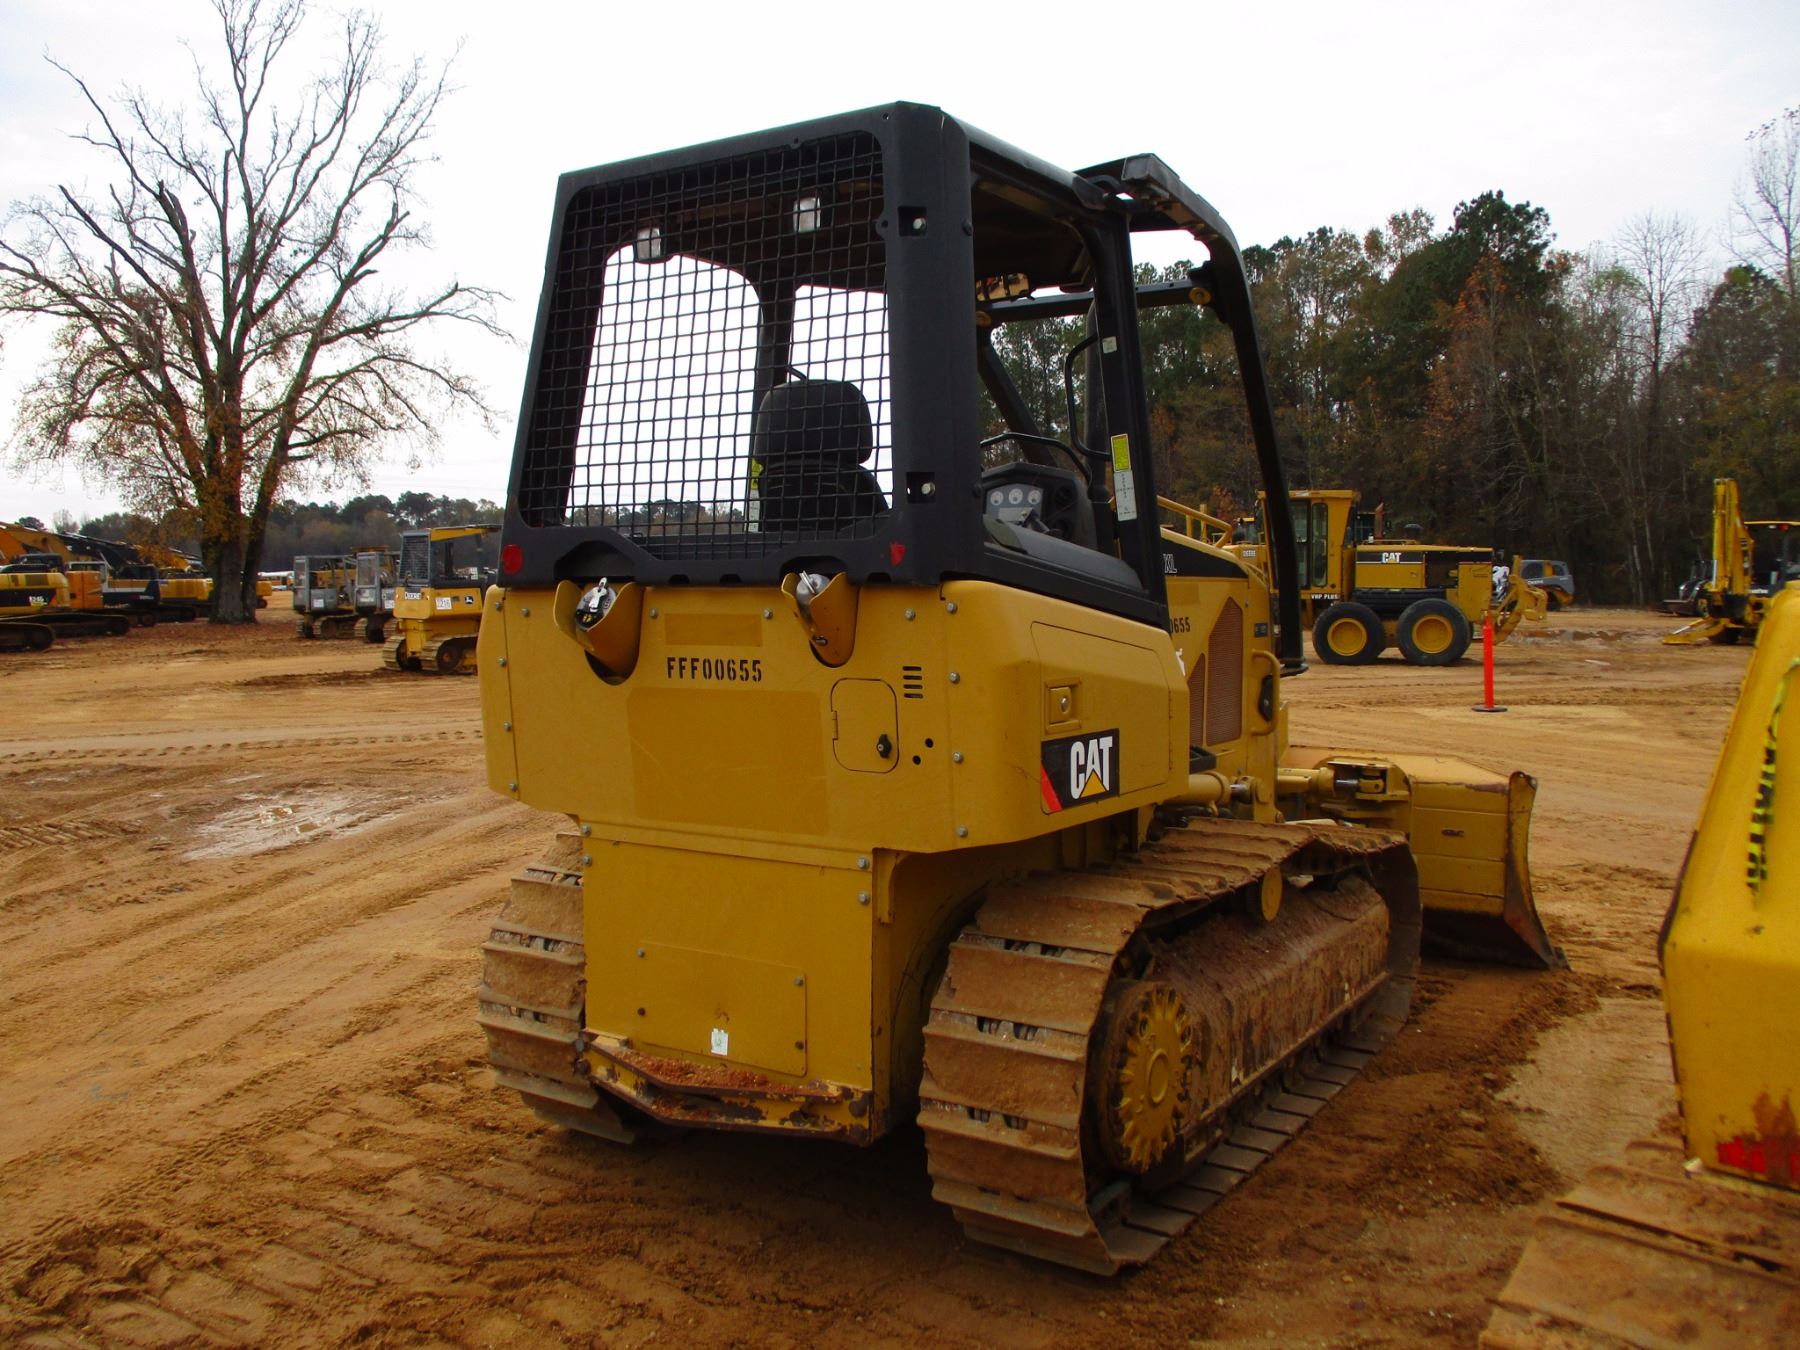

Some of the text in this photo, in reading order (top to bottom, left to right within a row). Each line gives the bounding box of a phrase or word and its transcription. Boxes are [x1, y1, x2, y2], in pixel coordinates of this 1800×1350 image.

[1381, 552, 1402, 564] CAT
[667, 656, 764, 682] FFF00655
[1070, 735, 1113, 799] CAT
